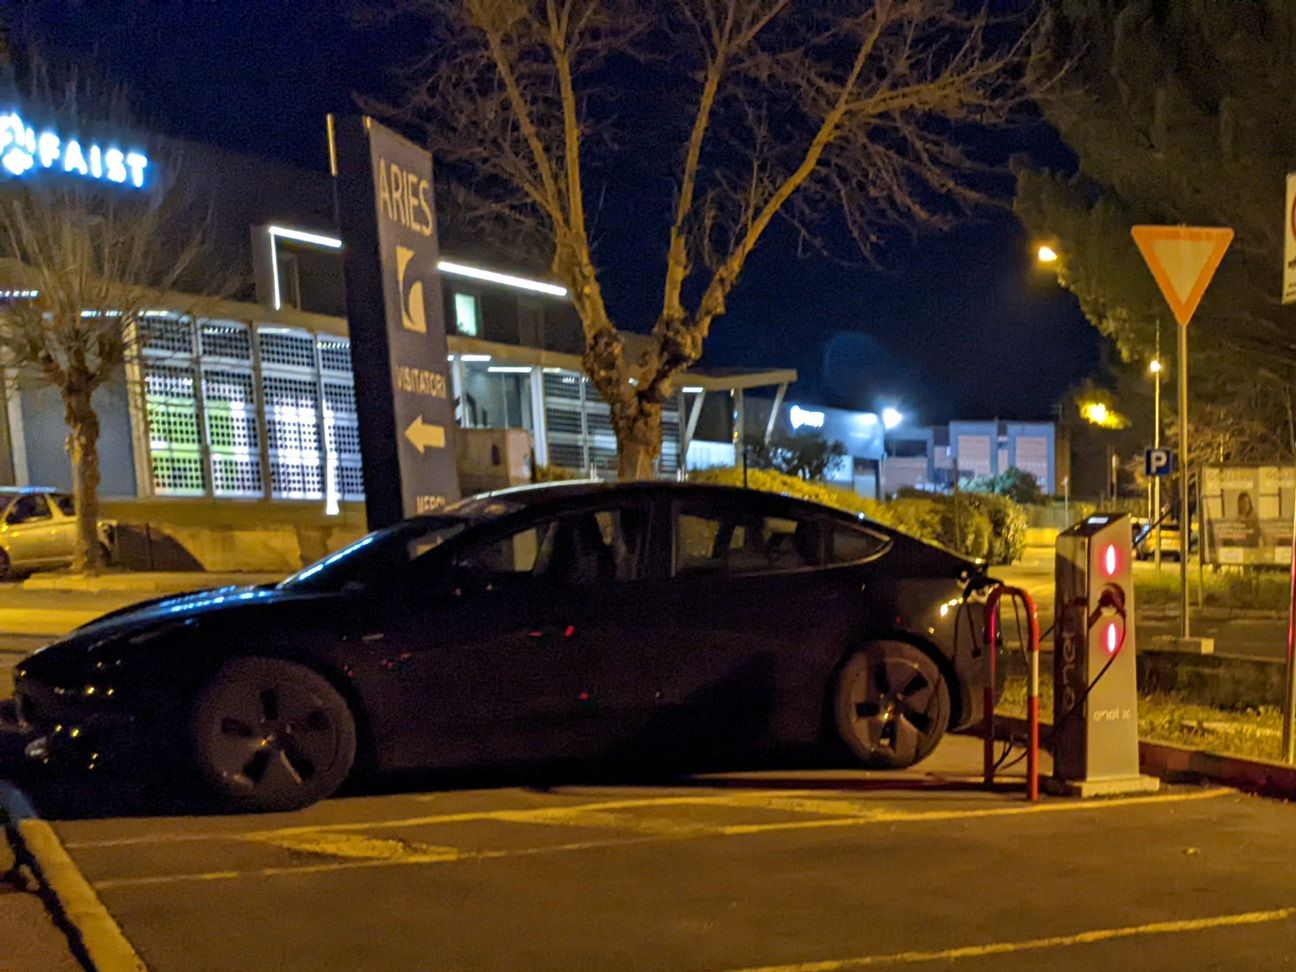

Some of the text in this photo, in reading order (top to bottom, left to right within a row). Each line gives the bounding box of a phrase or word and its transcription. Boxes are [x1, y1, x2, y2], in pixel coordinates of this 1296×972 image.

[39, 131, 148, 188] FAIST
[379, 157, 433, 237] ARIES
[395, 366, 446, 399] VISITATORI
[1151, 451, 1167, 474] P
